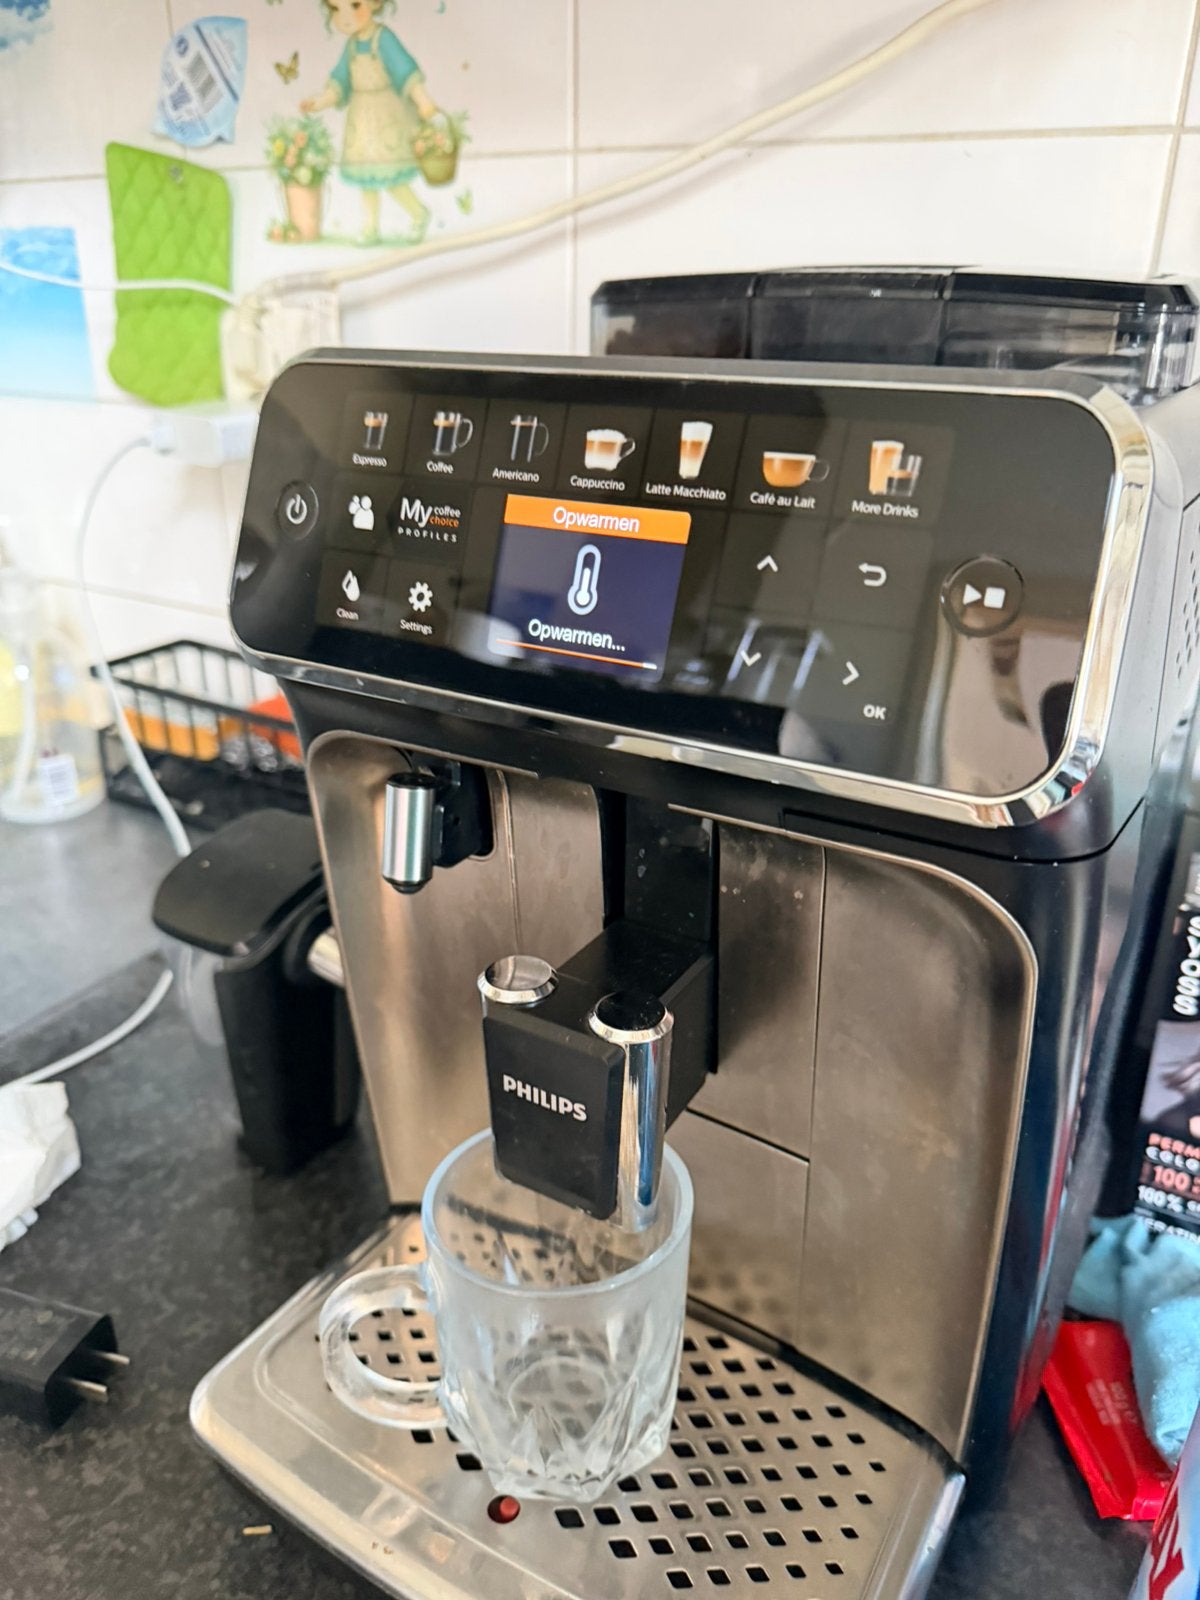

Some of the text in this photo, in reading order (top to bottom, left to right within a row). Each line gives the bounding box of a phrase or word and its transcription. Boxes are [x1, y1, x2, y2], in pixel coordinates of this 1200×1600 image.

[352, 453, 387, 467] Espresso
[426, 460, 454, 474] Coffee
[492, 467, 540, 483] Americano
[570, 475, 625, 491] Cappuccino
[645, 482, 726, 501] Latte Macchiato
[750, 491, 816, 509] Café au Lait
[400, 496, 461, 528] My coffee
[851, 500, 919, 518] More Drinks
[429, 515, 459, 528] choice
[552, 506, 640, 533] Opwarmen
[397, 525, 457, 543] PROFILES
[336, 607, 359, 621] Clean
[400, 619, 433, 635] Settings
[528, 618, 626, 652] Opwarmen...
[862, 704, 887, 720] OK
[503, 1074, 587, 1122] PHILIPS
